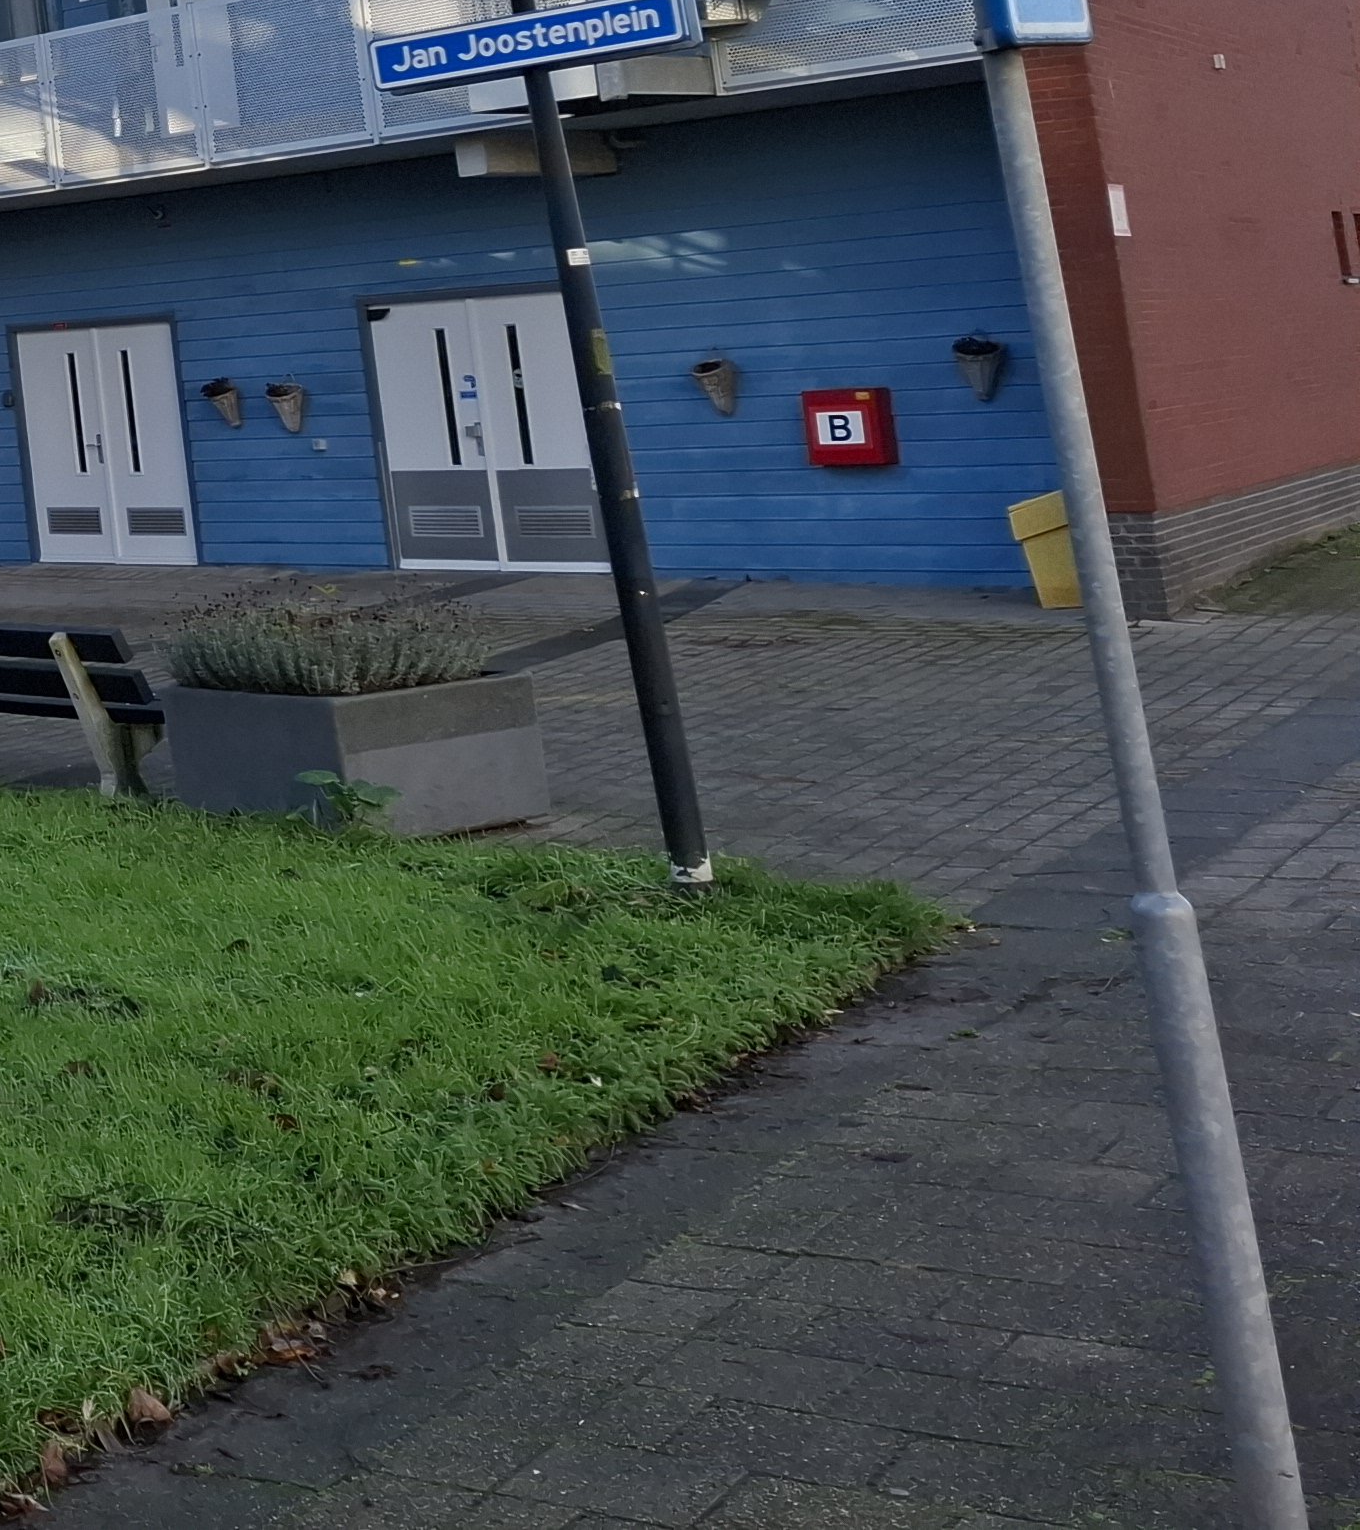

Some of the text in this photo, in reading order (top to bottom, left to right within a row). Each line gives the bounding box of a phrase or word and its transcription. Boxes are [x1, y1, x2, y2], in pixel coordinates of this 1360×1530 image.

[392, 5, 661, 73] Jan Joostenplein
[828, 415, 852, 442] B
